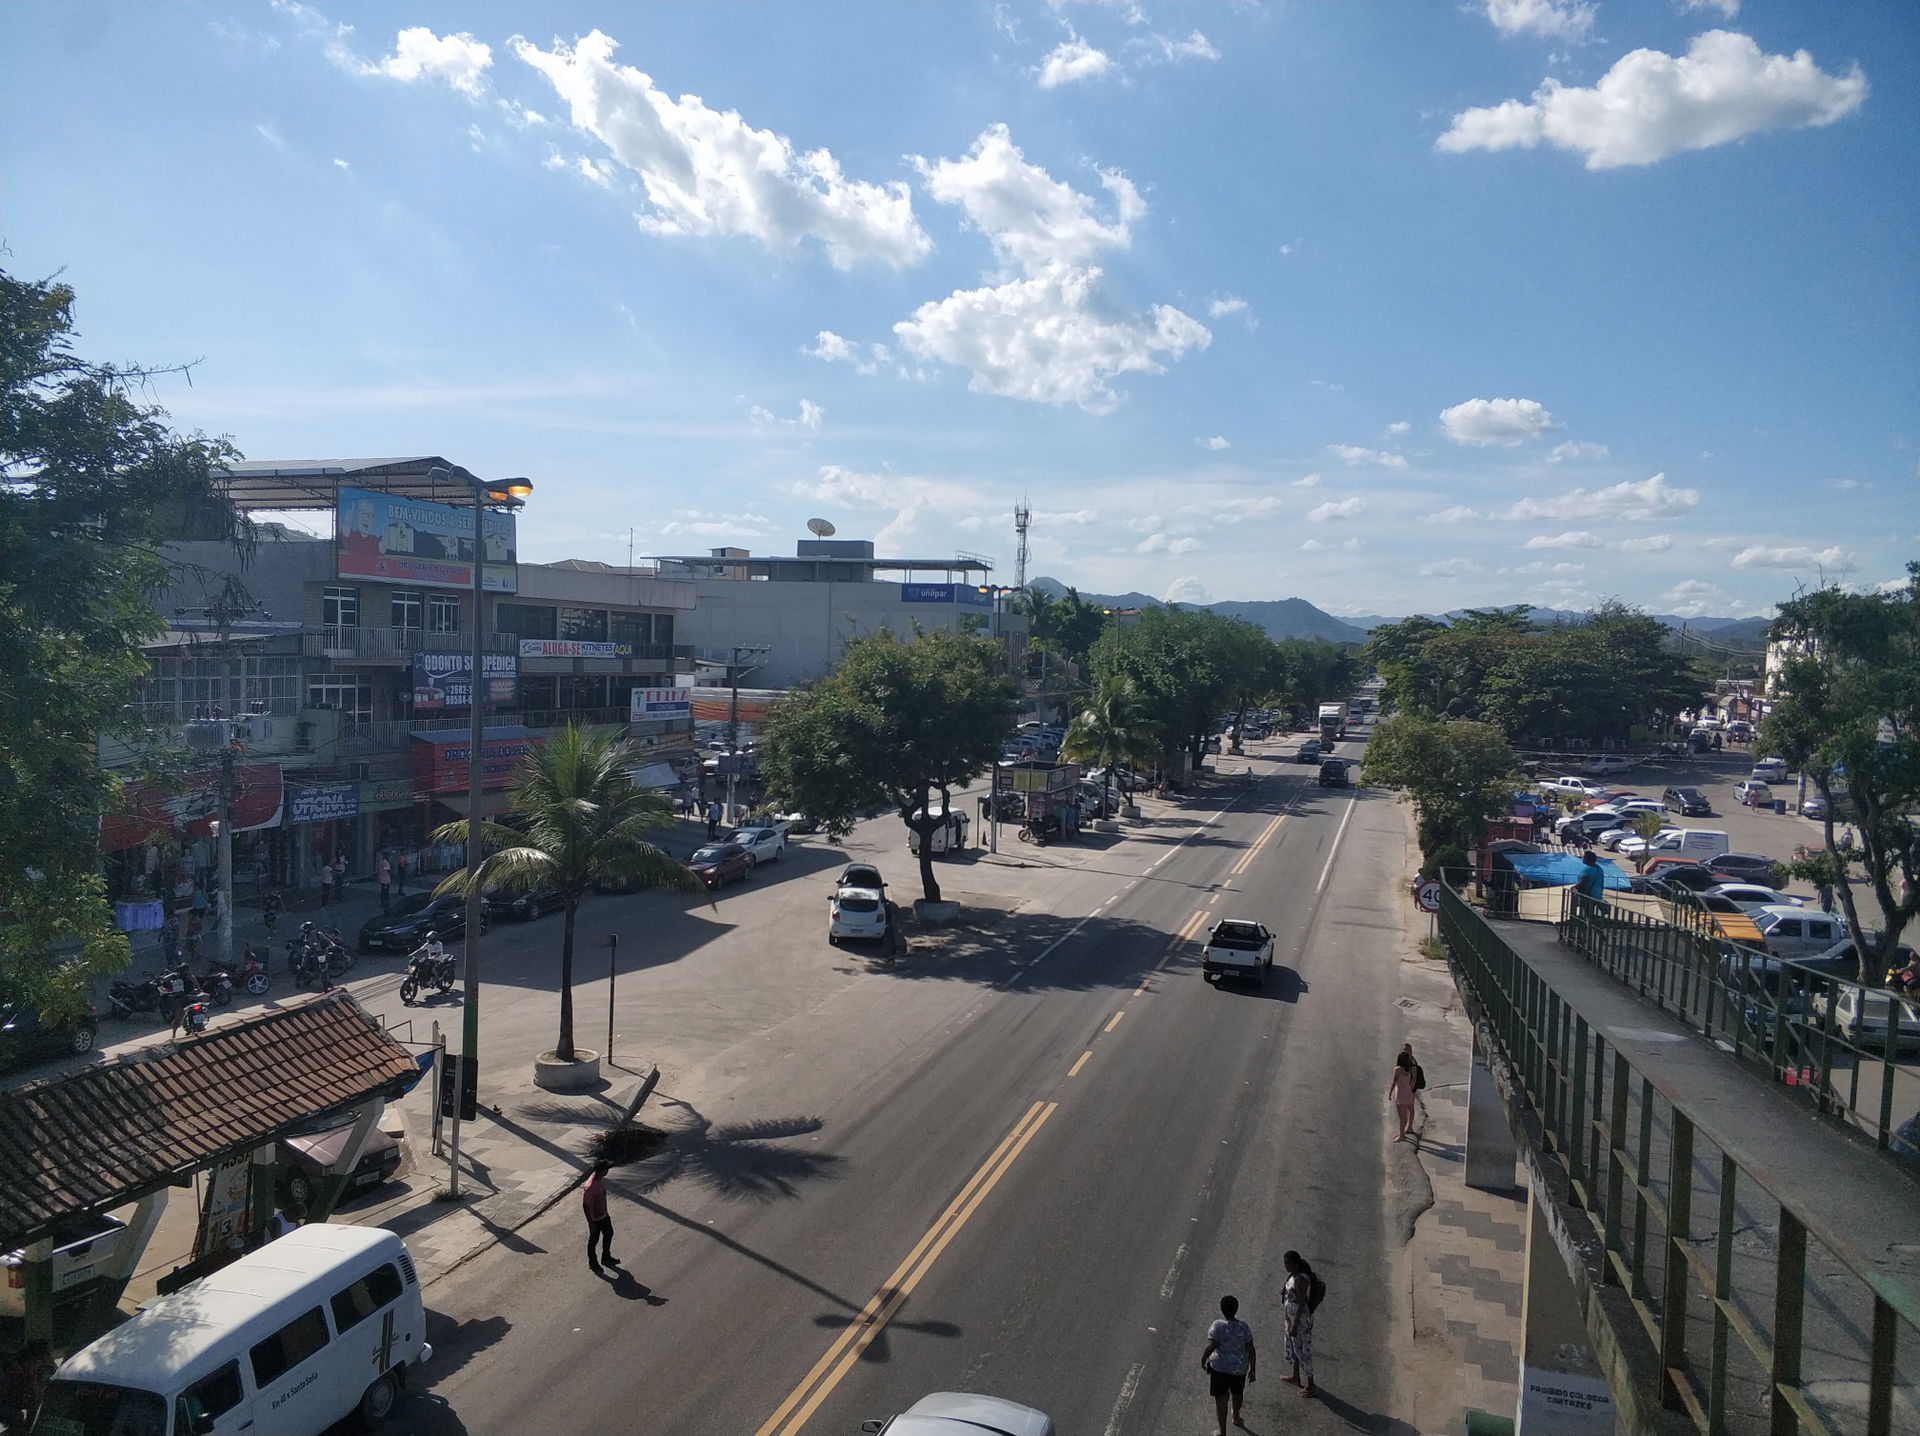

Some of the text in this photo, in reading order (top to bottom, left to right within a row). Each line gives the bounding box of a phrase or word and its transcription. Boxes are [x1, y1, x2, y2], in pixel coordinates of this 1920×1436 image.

[920, 590, 947, 599] unopar
[543, 642, 581, 656] ALUGA-SE
[615, 644, 632, 655] AQUI
[425, 655, 463, 670] ODONTO
[292, 795, 346, 815] OFICINA
[1546, 1396, 1593, 1410] CARTAZES
[1569, 1391, 1610, 1404] COLOCAR
